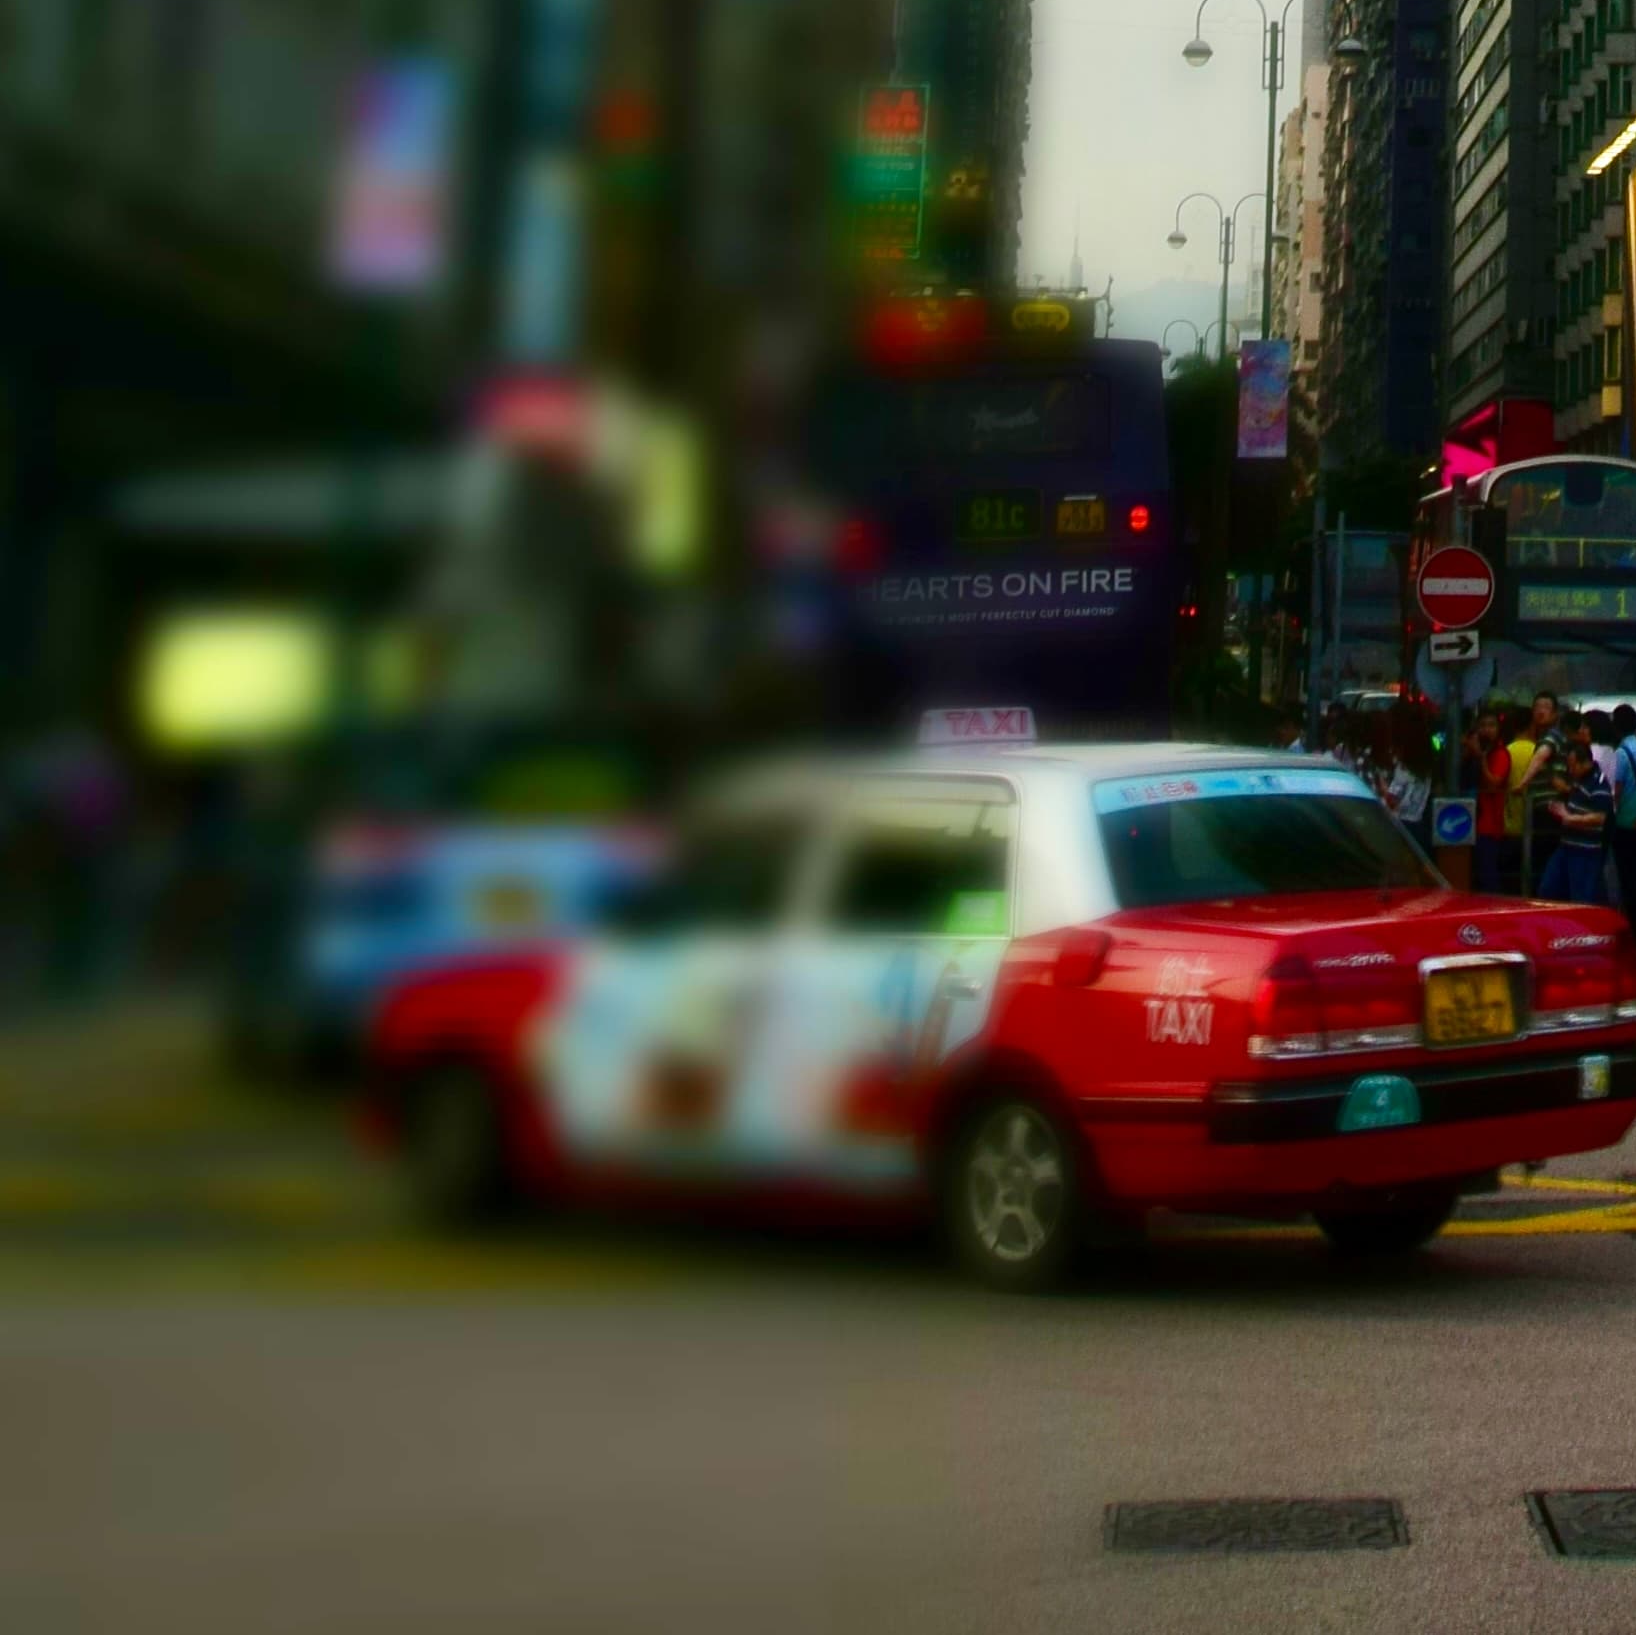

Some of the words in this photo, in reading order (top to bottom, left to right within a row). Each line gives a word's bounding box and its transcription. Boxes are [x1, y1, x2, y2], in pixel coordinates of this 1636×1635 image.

[856, 573, 994, 602] HEARTS
[1002, 571, 1050, 597] ON
[1061, 568, 1134, 595] FIRE
[948, 610, 977, 624] MOST
[981, 608, 1037, 621] PERFECTLY
[1039, 607, 1061, 619] CUT
[1064, 605, 1115, 618] DIAMOND
[1616, 589, 1630, 618] 1
[944, 710, 1028, 735] TAXI
[1144, 999, 1216, 1046] TAXI
